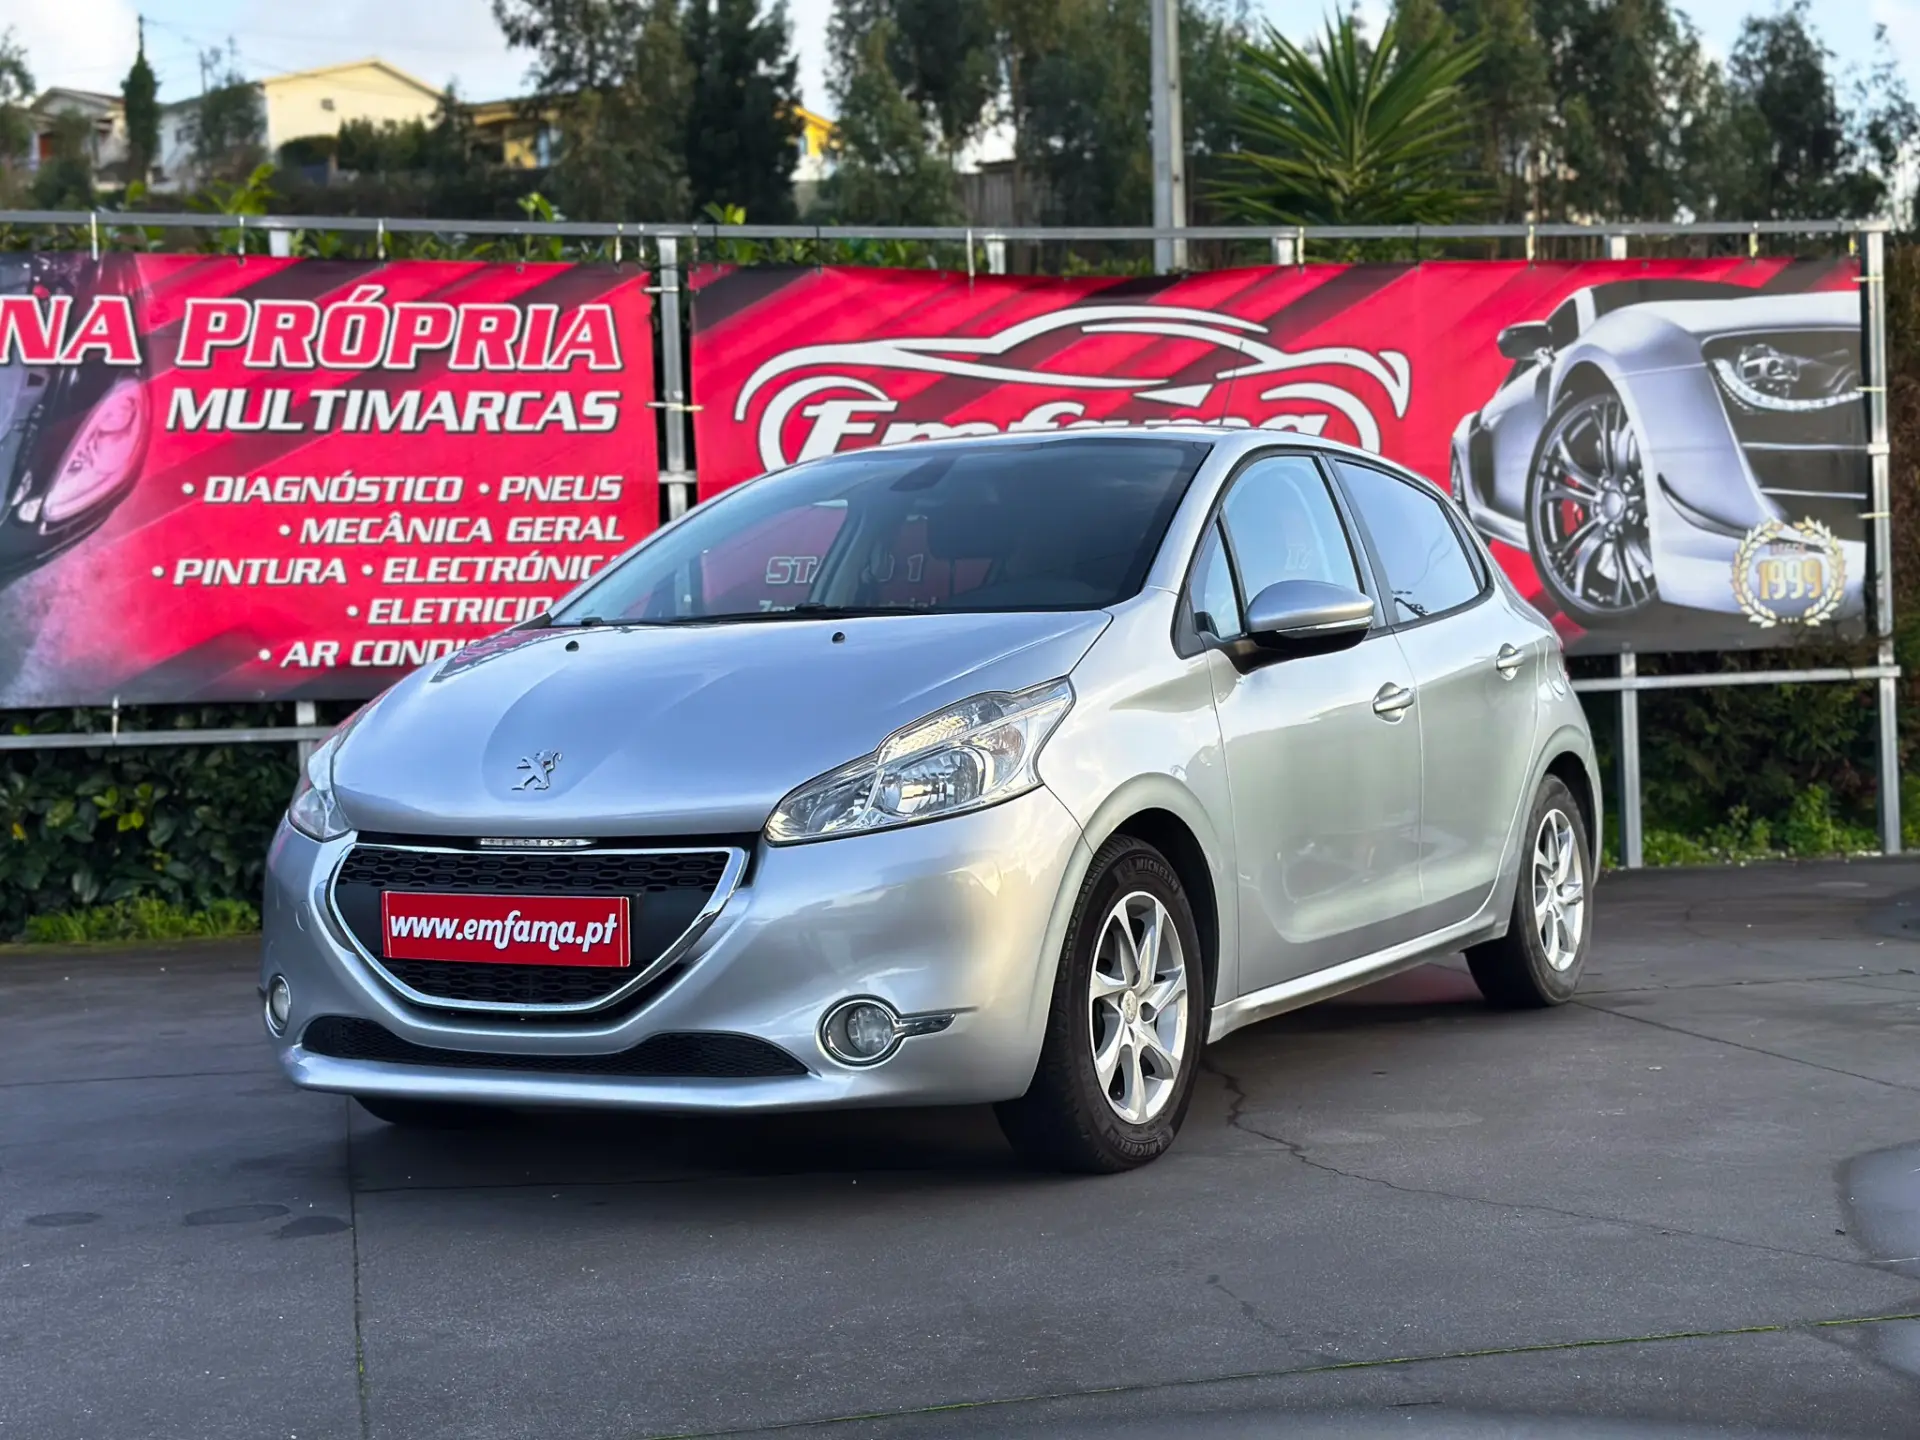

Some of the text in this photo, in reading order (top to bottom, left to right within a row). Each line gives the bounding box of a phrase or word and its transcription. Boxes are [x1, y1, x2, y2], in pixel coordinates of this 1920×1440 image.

[0, 286, 624, 371] NA PRÓPRIA
[166, 388, 621, 432] MULTIMARCAS
[204, 471, 624, 504] DIAGNÓSTICO PNEUS
[300, 512, 625, 545] MECÂNICA GERAL
[174, 551, 619, 586] PINTURA ELECTRÓNIC
[1756, 558, 1822, 600] 1999
[280, 639, 478, 668] AR COND
[1135, 858, 1179, 892] MICHELIN
[389, 909, 618, 953] www.emfama.pt
